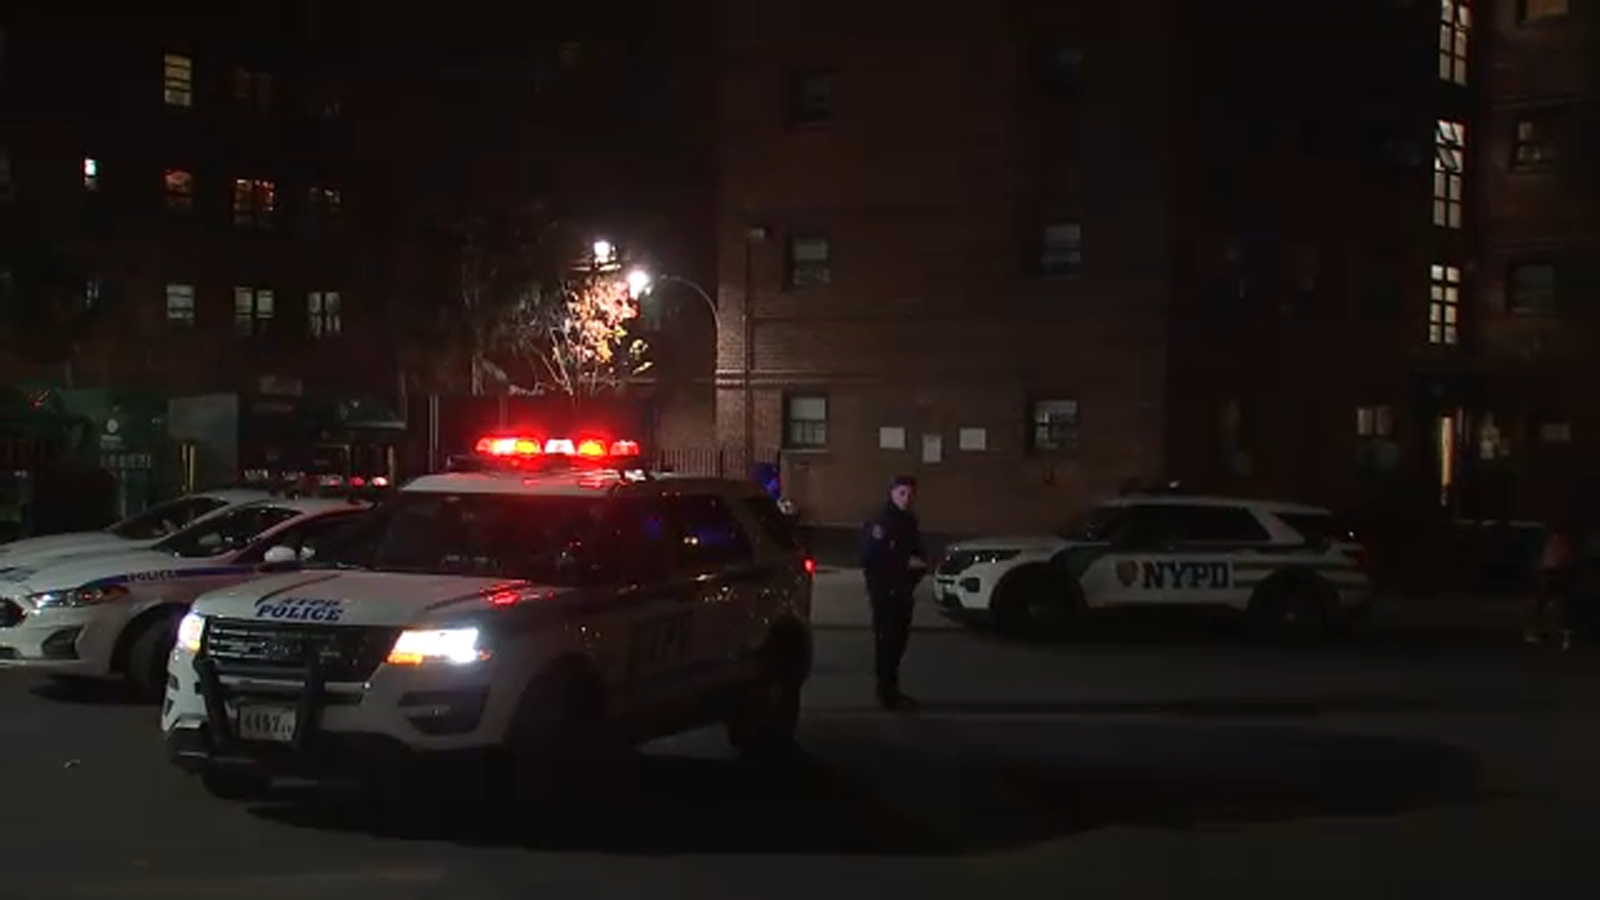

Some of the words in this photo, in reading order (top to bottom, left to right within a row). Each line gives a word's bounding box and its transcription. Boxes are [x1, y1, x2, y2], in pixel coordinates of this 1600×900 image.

[130, 569, 176, 582] POLICE
[1143, 561, 1228, 588] NYPD
[256, 604, 342, 621] POLICE
